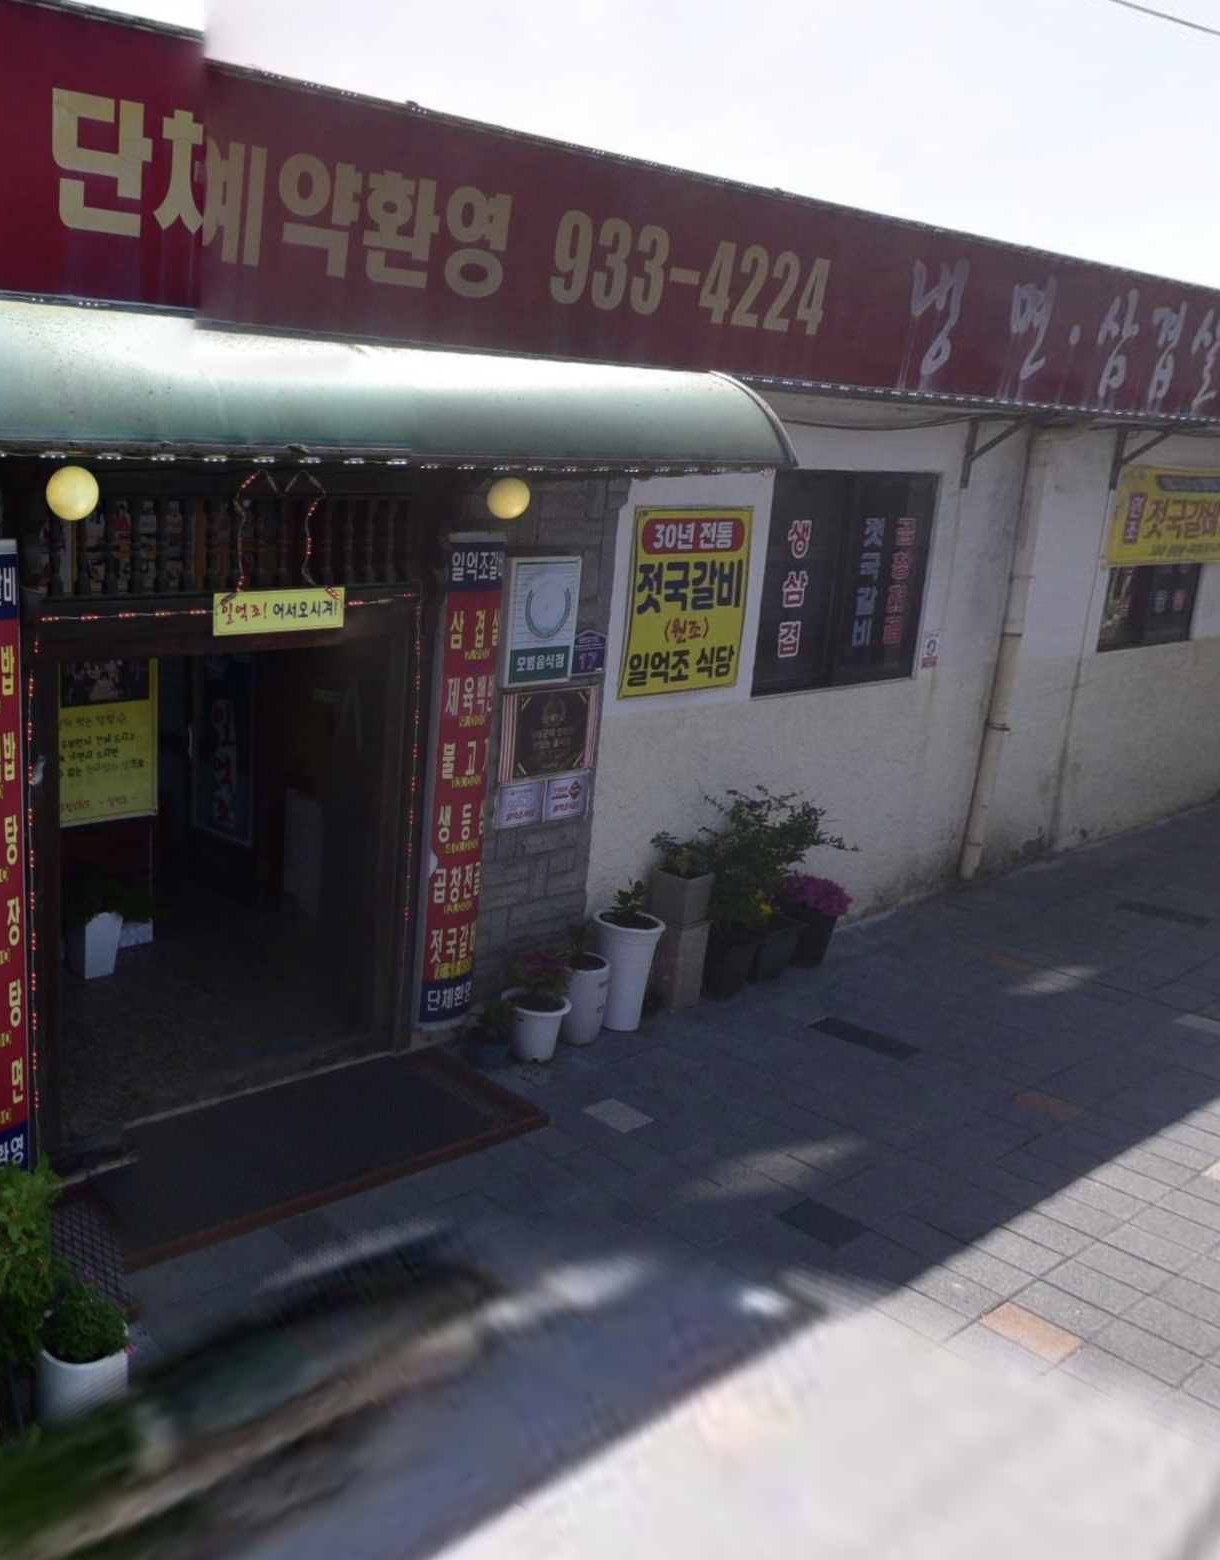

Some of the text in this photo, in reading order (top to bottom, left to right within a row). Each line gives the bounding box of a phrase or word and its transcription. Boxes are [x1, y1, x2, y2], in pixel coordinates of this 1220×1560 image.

[549, 209, 831, 336] 933-4224
[653, 521, 734, 550] 30년 전통
[637, 559, 744, 615] 젓국갈비
[221, 602, 268, 626] 일억조!
[664, 616, 709, 645] (원조)
[516, 653, 564, 672] 모범음식점
[627, 645, 735, 687] 일억조 식당
[427, 981, 472, 1012] 단체환영
